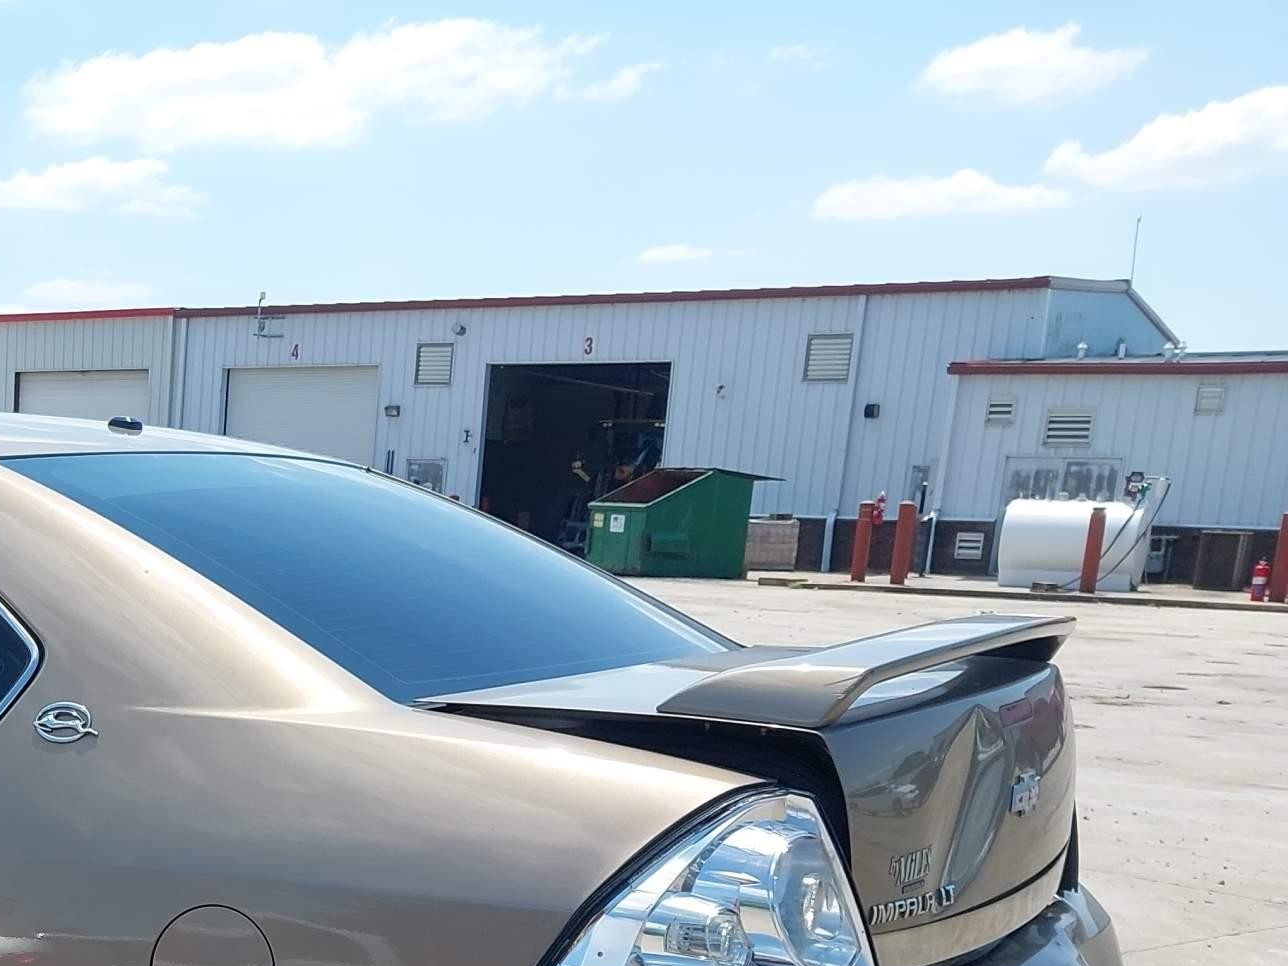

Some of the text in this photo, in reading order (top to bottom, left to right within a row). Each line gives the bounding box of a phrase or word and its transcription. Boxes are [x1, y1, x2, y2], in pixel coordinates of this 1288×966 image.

[291, 343, 299, 361] 4
[584, 337, 593, 356] 3
[870, 892, 937, 925] IMPALA
[939, 884, 955, 906] LT
